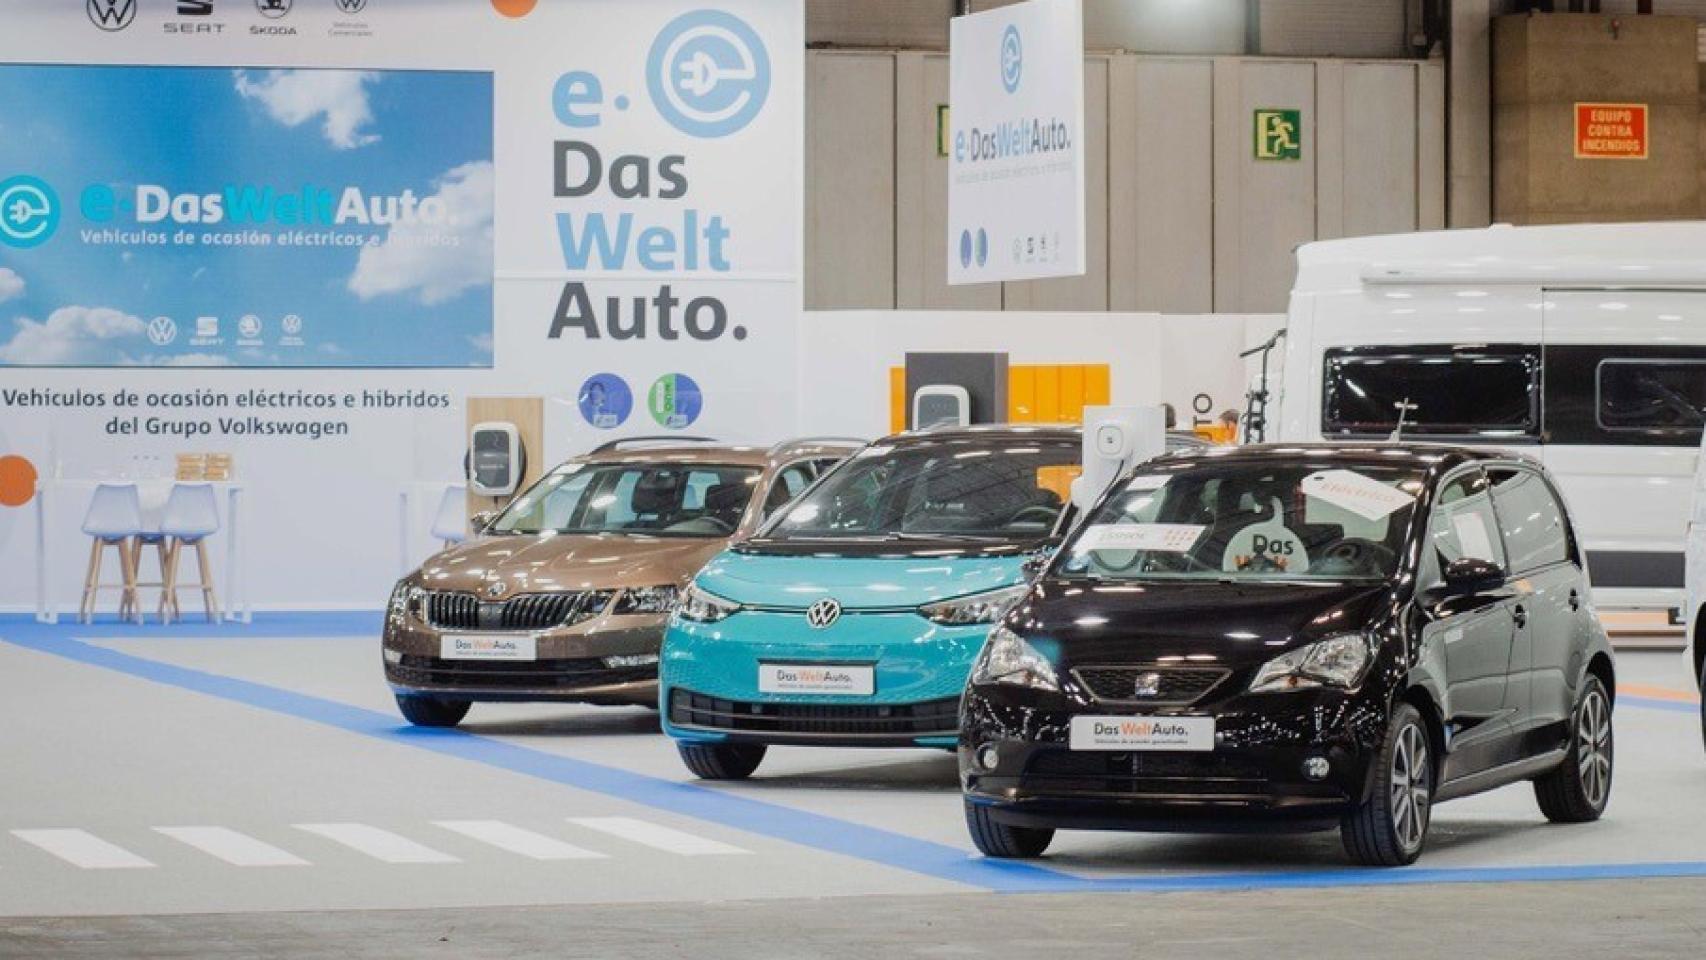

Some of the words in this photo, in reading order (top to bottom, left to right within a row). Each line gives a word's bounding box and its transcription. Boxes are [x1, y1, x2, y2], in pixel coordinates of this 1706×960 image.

[163, 23, 224, 33] SEAT
[1590, 108, 1632, 123] EQUIPO
[1587, 124, 1634, 137] CONTRA
[1582, 138, 1640, 152] INCENDIOS
[553, 140, 688, 199] Das
[174, 230, 195, 245] de
[202, 230, 272, 245] ocasión
[277, 231, 363, 247] eléctricos
[367, 235, 380, 247] e
[555, 209, 730, 271] Welt
[547, 282, 748, 341] Auto.
[2, 388, 106, 407] Vehículos
[113, 389, 139, 407] de
[146, 389, 229, 407] ocasión
[235, 389, 337, 408] eléctricos
[344, 394, 356, 408] e
[105, 417, 138, 434] del
[145, 417, 212, 438] Grupo
[218, 417, 348, 439] Volkswagen
[1253, 534, 1294, 555] Das
[776, 669, 798, 681] Das
[1094, 722, 1119, 736] Das
